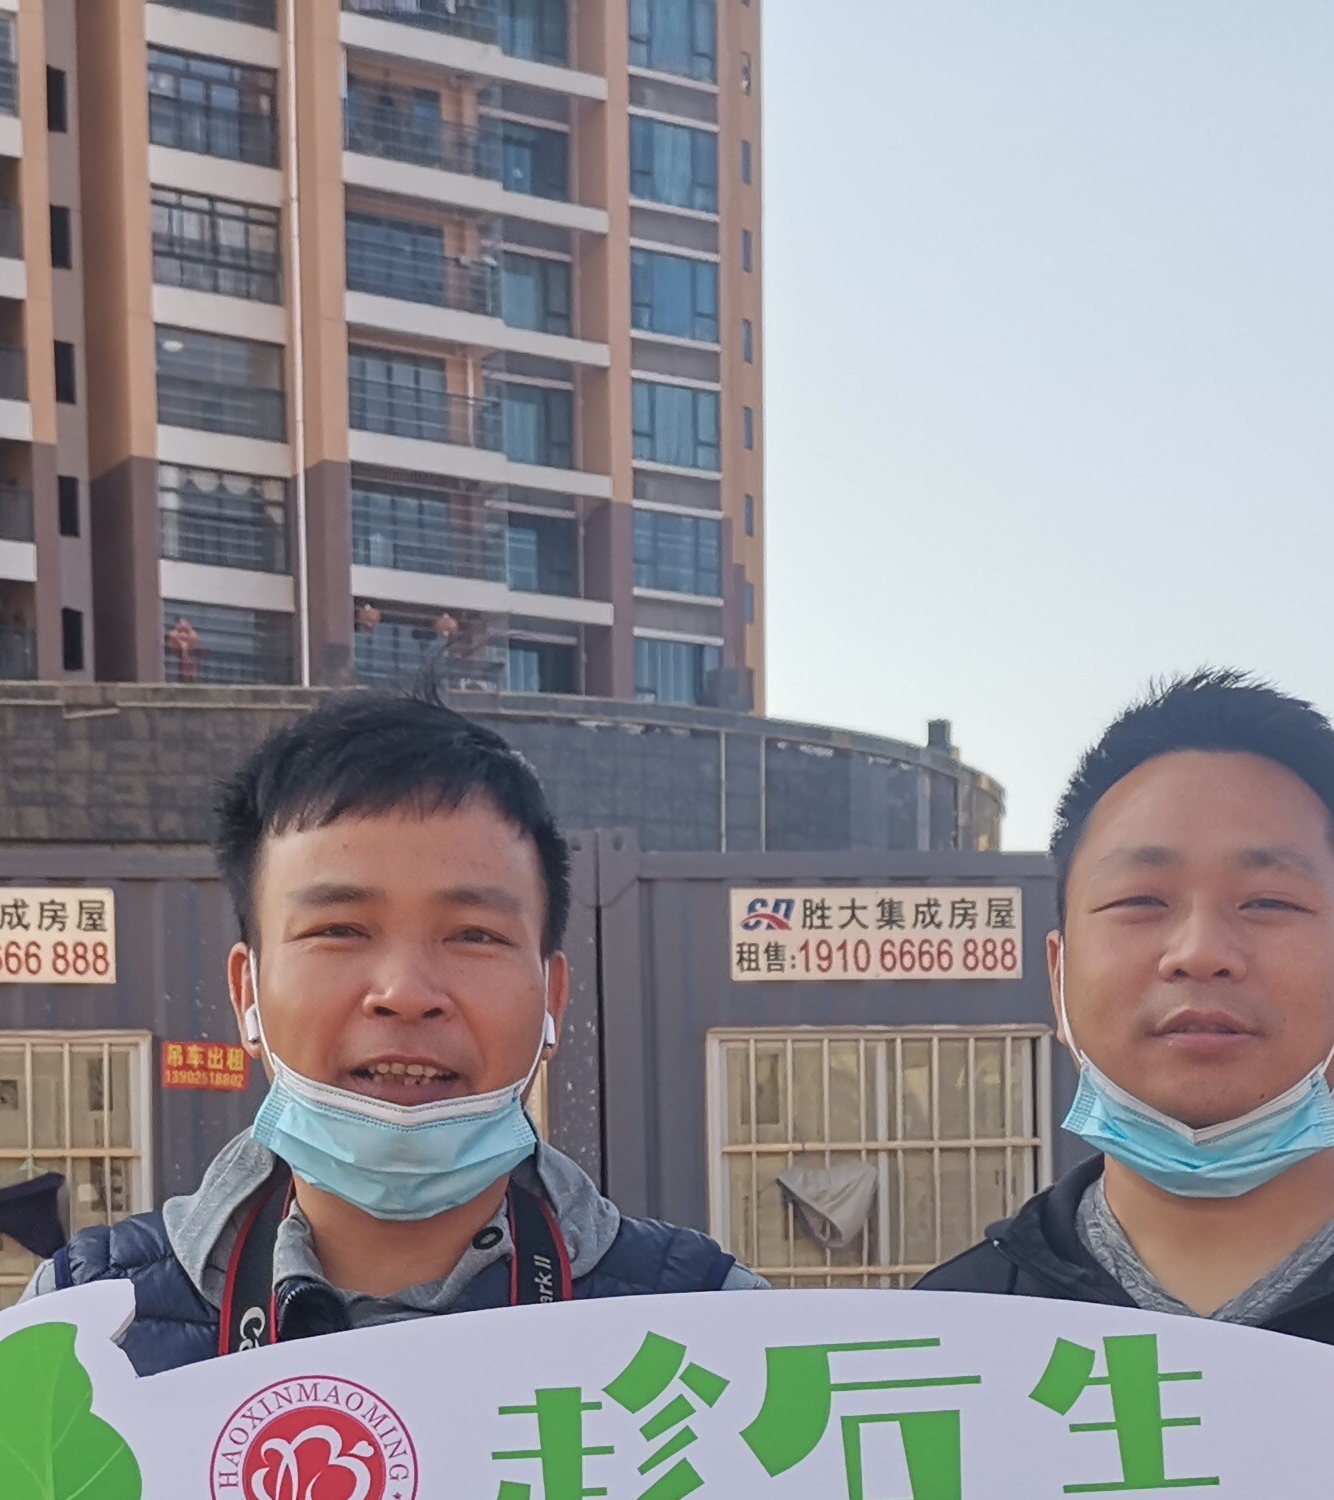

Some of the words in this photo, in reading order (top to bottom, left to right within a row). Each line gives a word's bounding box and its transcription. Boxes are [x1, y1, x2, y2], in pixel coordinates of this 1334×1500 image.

[800, 896, 1017, 931] 胜大集成房屋
[166, 1043, 245, 1071] 吊车出租
[218, 1382, 410, 1489] HAOXINMAOMING
